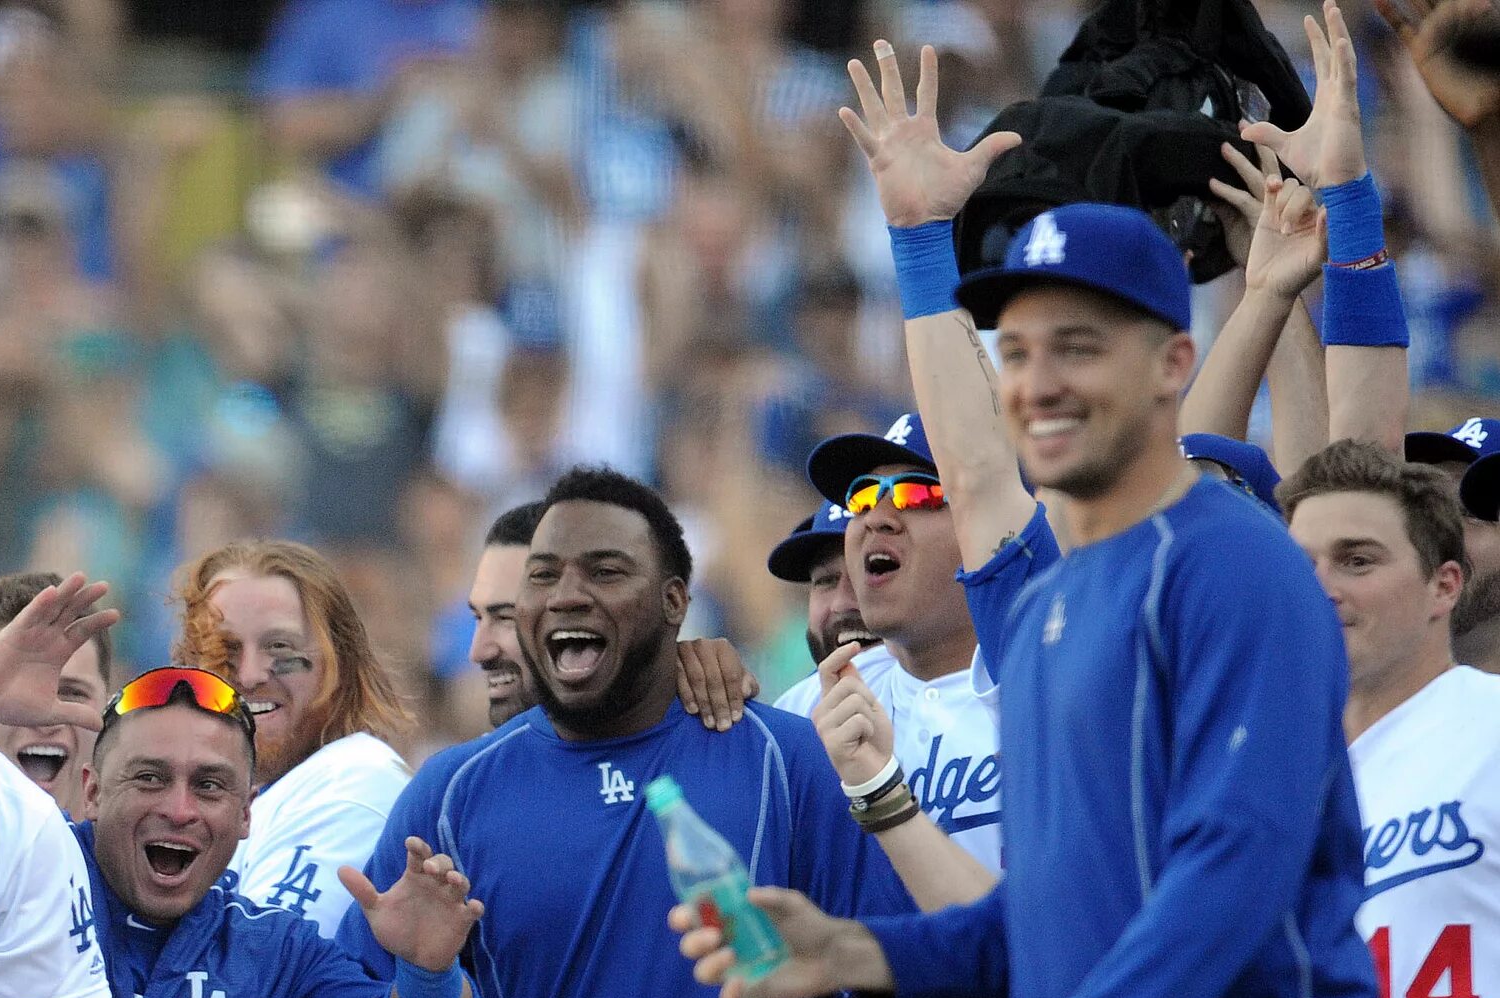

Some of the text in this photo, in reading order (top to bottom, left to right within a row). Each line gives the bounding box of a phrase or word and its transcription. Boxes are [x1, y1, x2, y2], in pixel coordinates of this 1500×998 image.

[1453, 417, 1488, 449] LA
[598, 762, 635, 805] LA
[266, 845, 322, 917] LA
